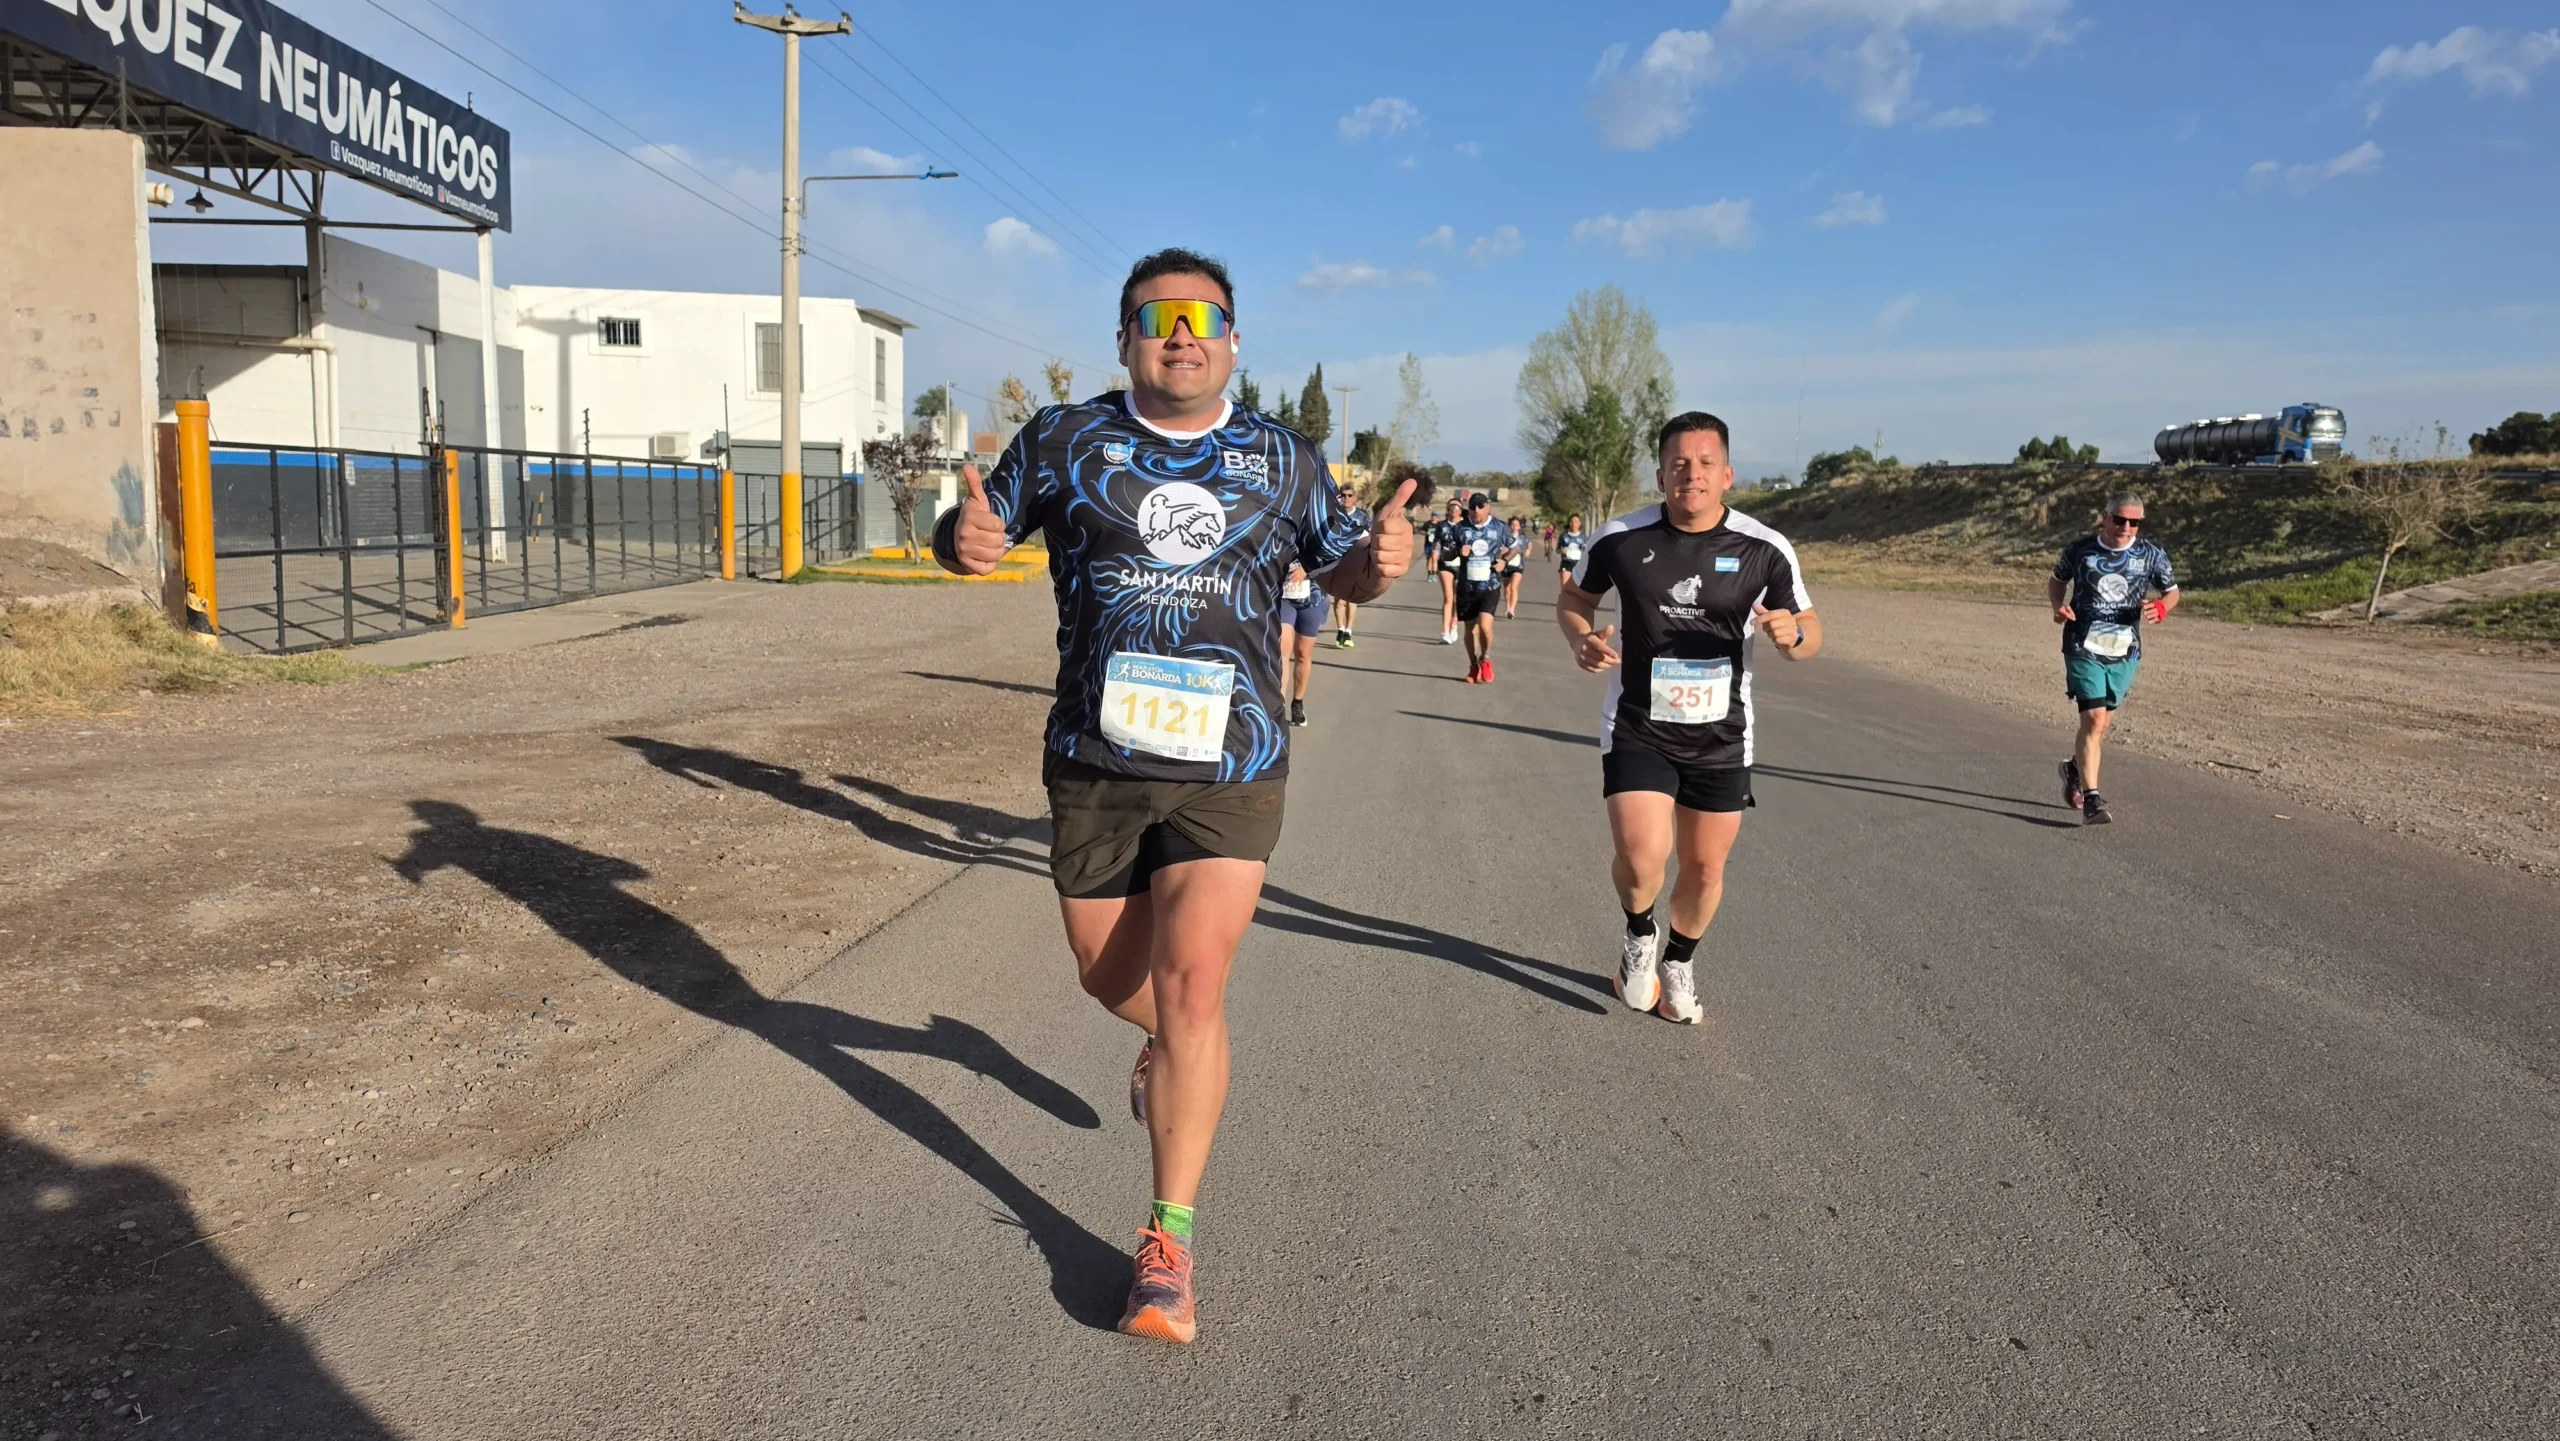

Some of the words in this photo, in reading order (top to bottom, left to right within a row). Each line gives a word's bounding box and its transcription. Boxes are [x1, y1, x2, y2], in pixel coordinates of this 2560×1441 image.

[43, 0, 243, 91] QUEZ
[260, 30, 498, 200] NEUMÁTICOS
[341, 146, 382, 176] Vazquez
[382, 166, 434, 197] neumaticos
[444, 188, 499, 223] Vazneumaticos
[1119, 569, 1158, 588] SAN
[1162, 571, 1233, 596] MARTÍN
[1139, 593, 1208, 610] MENDOZA
[1659, 605, 1706, 617] PROACTIVE
[1131, 669, 1182, 685] BONARDA
[1669, 685, 1714, 708] 251
[1120, 692, 1210, 737] 1121
